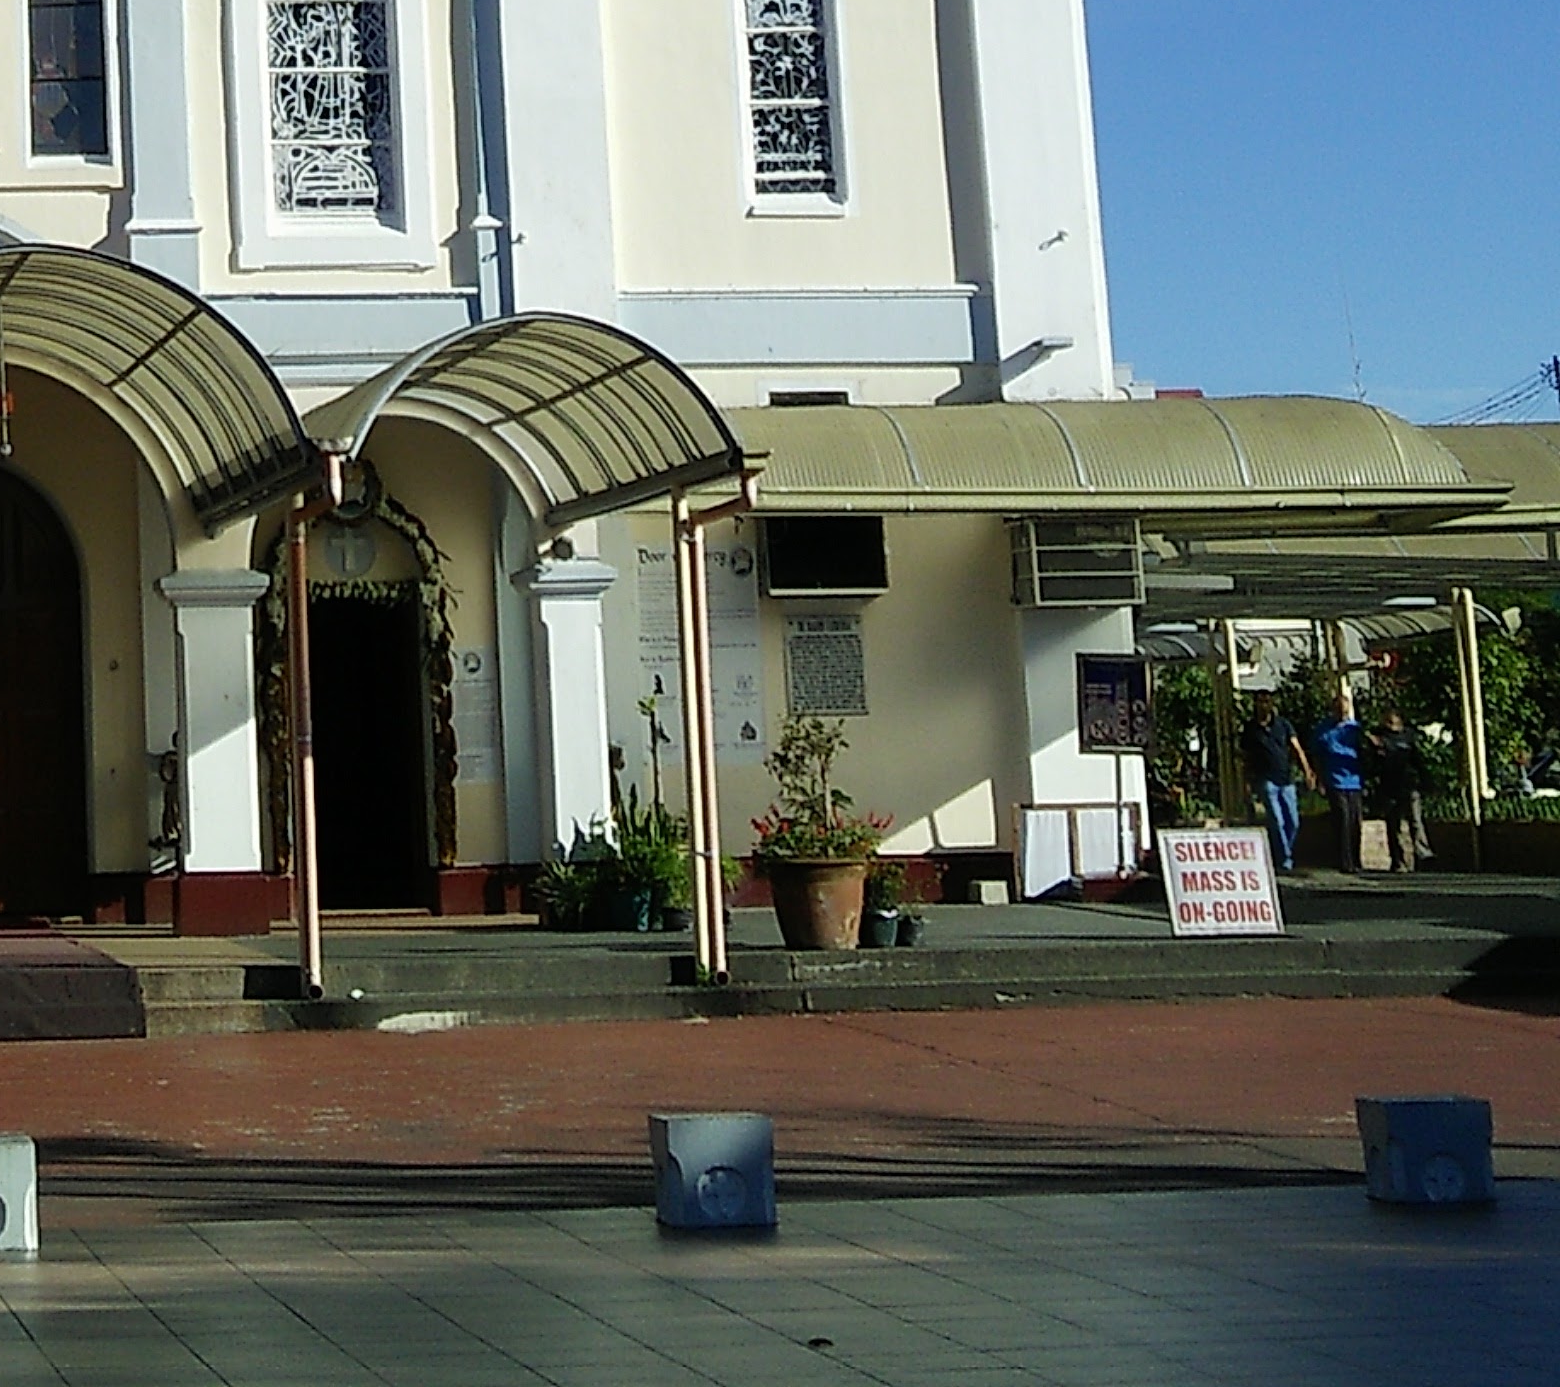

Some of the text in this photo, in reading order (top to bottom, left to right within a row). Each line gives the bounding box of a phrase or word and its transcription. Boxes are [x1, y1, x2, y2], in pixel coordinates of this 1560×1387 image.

[1175, 841, 1257, 862] SILENCE!
[1181, 870, 1261, 893] MASS IS
[1179, 900, 1272, 924] ON-GOING
